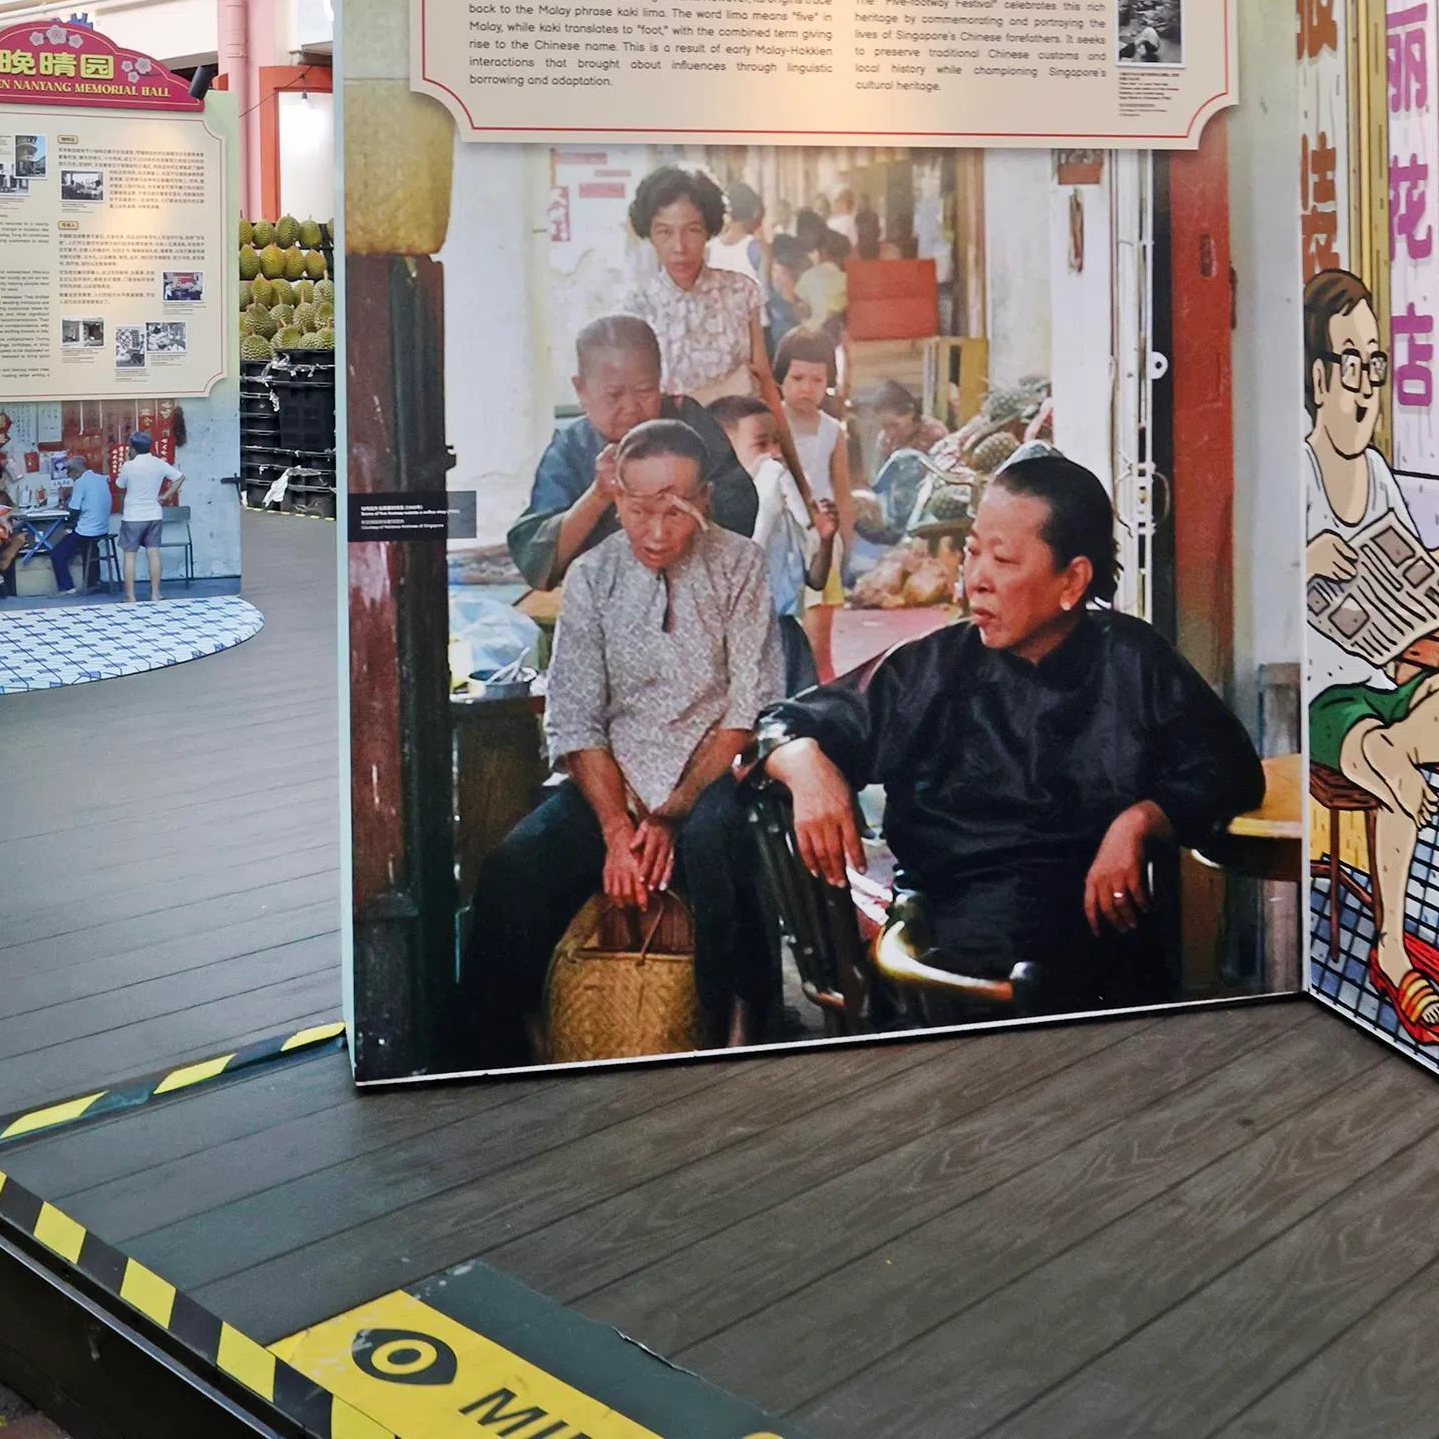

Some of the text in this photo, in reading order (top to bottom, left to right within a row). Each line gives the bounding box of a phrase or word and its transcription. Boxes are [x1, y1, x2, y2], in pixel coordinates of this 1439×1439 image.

[468, 56, 833, 75] interactions that brought about influences through linguistic
[13, 80, 72, 93] NANYANG
[74, 83, 139, 96] MEMORIAL
[141, 86, 172, 98] HALL
[468, 74, 525, 87] borrowing
[526, 75, 549, 85] and
[458, 1387, 592, 1439] MI
